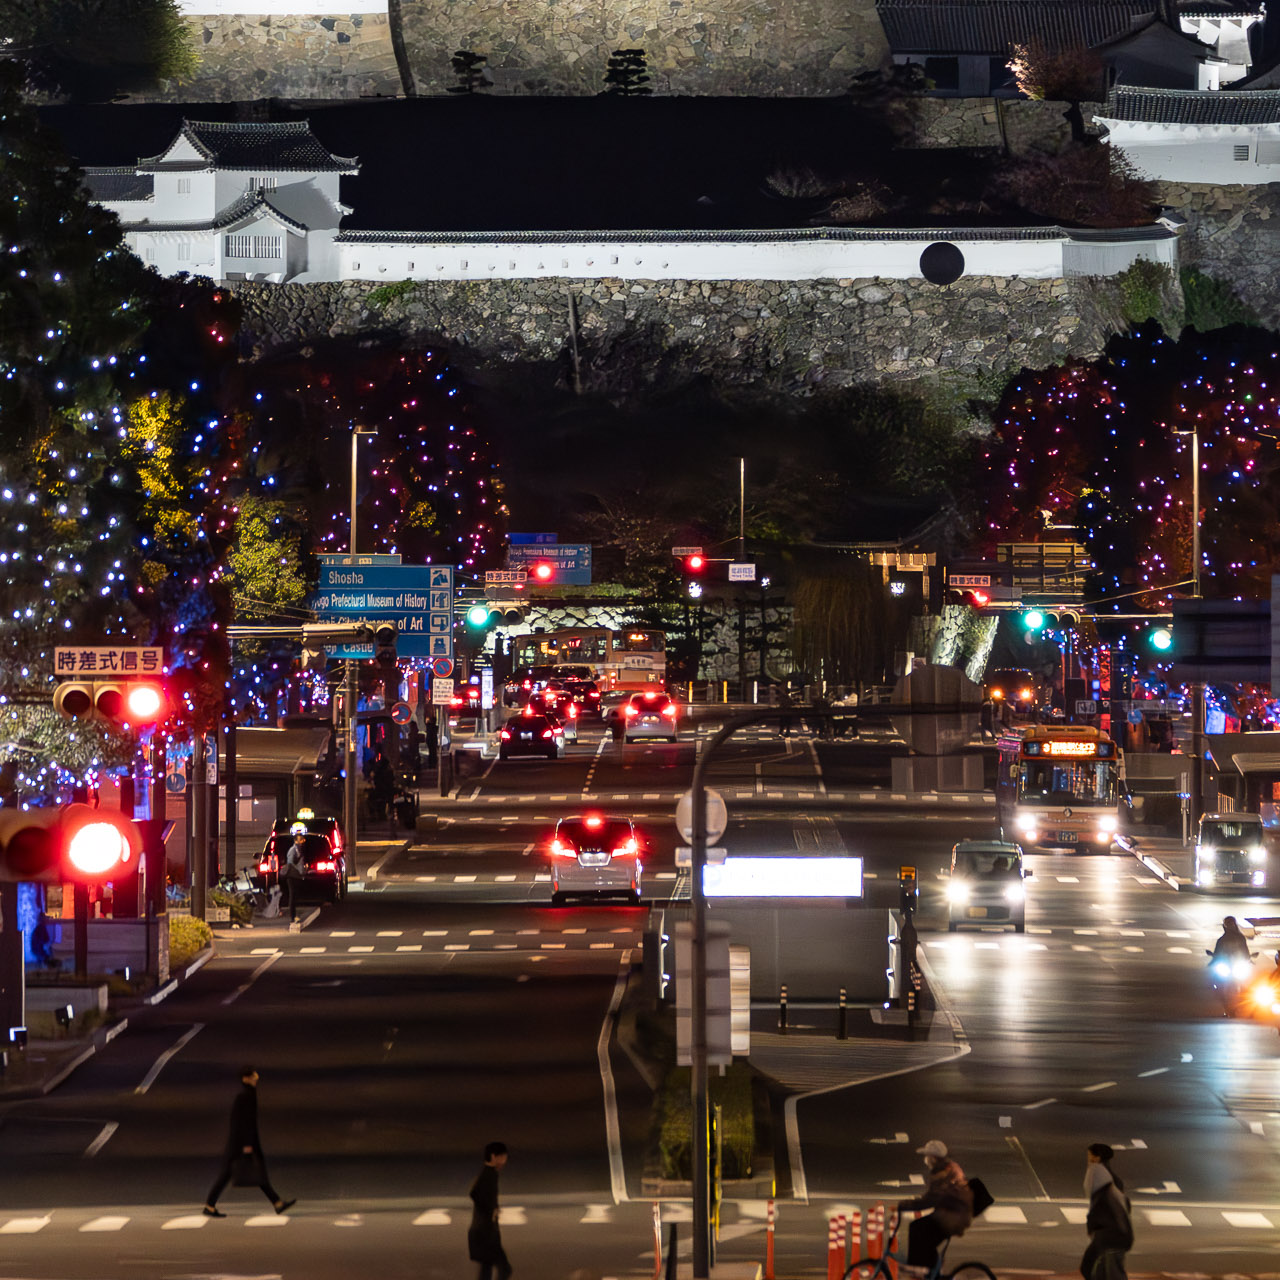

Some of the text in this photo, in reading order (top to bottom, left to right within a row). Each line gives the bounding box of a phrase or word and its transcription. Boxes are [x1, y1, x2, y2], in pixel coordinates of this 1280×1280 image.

[328, 571, 364, 585] Shosha
[331, 593, 366, 607] Prefectural
[367, 593, 394, 607] Museum
[395, 593, 403, 607] of
[404, 593, 427, 610] History
[397, 616, 407, 631] of
[410, 617, 423, 631] Art
[57, 650, 160, 672] 時差式信号
